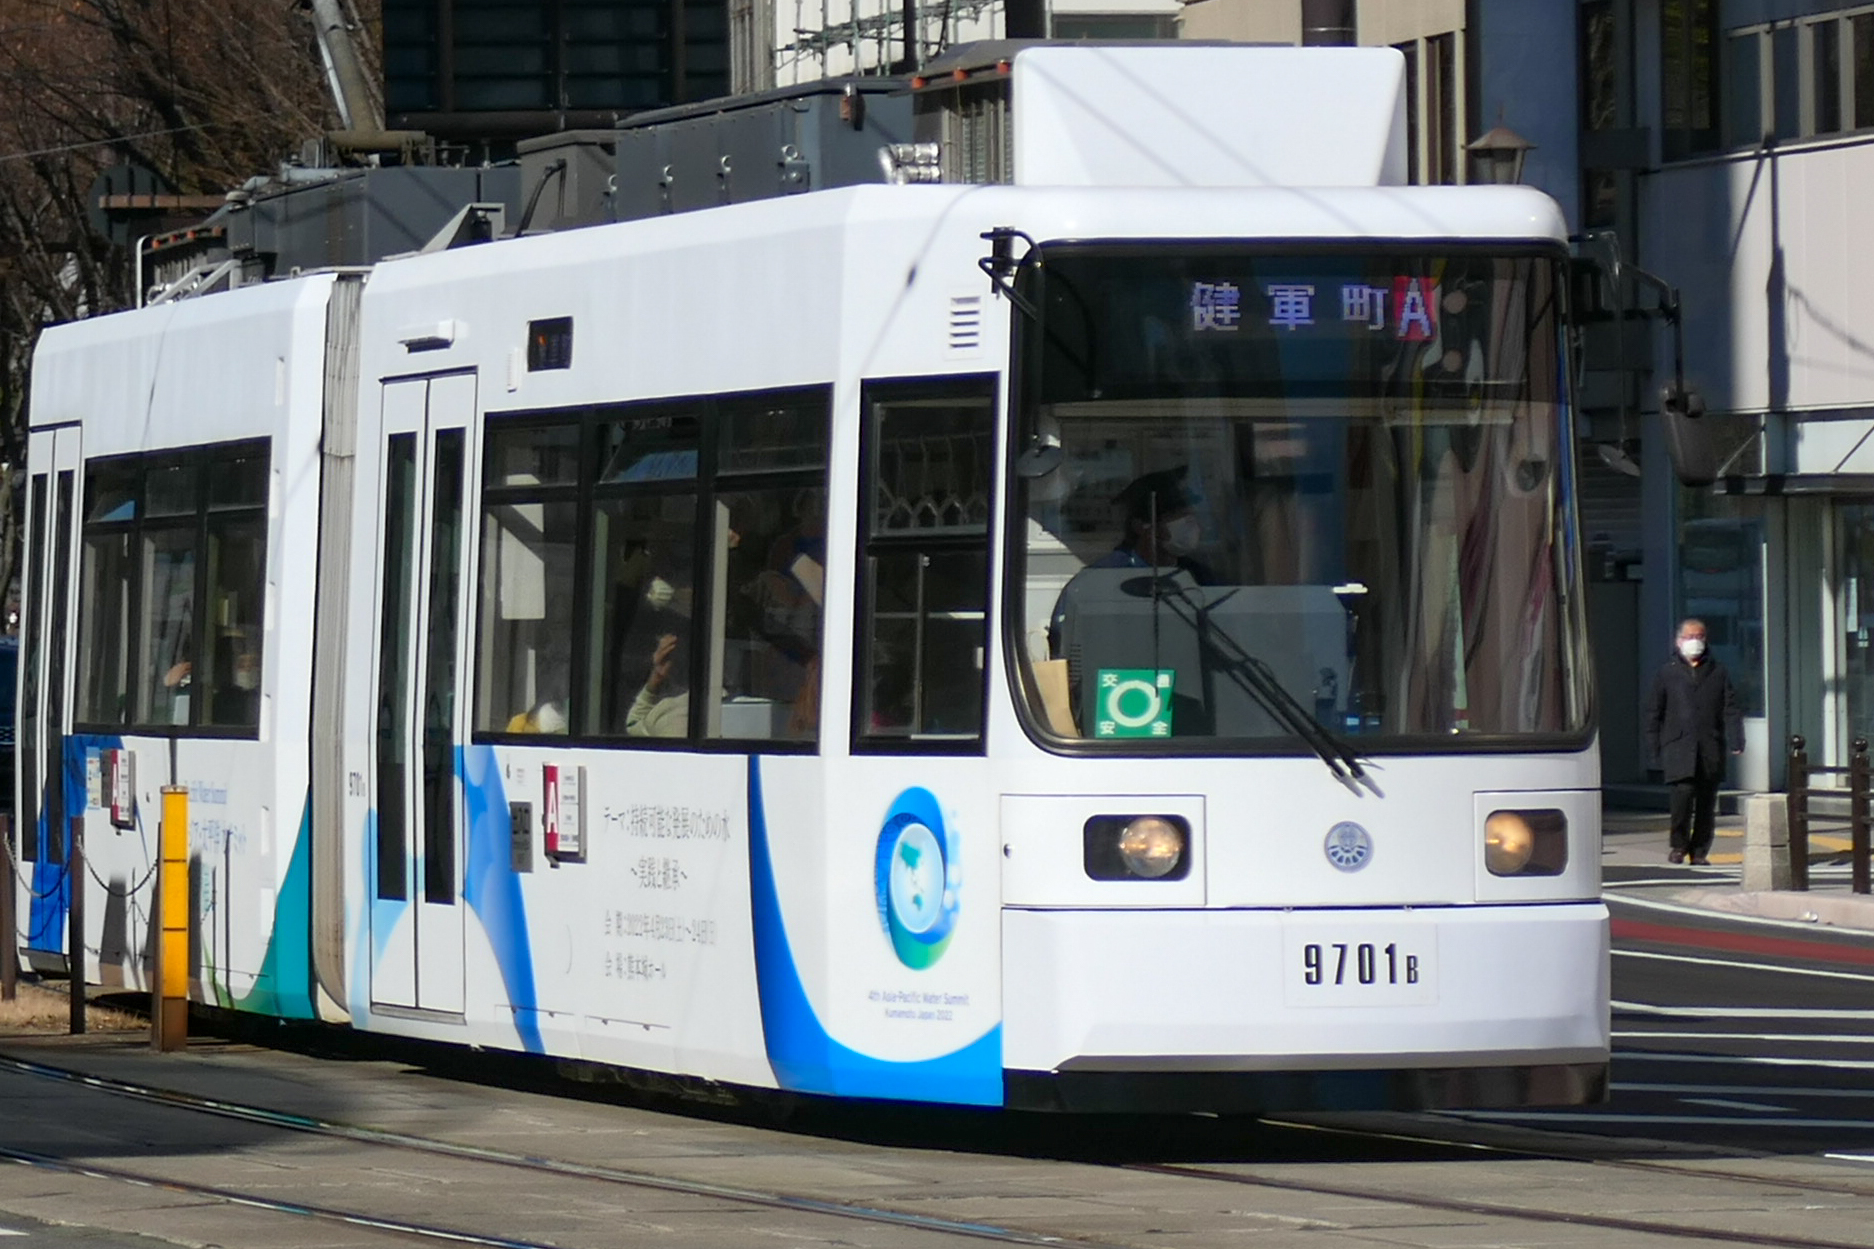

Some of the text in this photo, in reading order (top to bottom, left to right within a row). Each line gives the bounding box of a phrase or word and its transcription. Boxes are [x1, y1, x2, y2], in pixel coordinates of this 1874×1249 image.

[1191, 281, 1430, 338] 健軍町 A
[546, 781, 559, 834] A
[868, 990, 970, 1006] 4th Asia-Pacific Water Summit
[885, 1008, 953, 1021] Kumamoto Japan 2022
